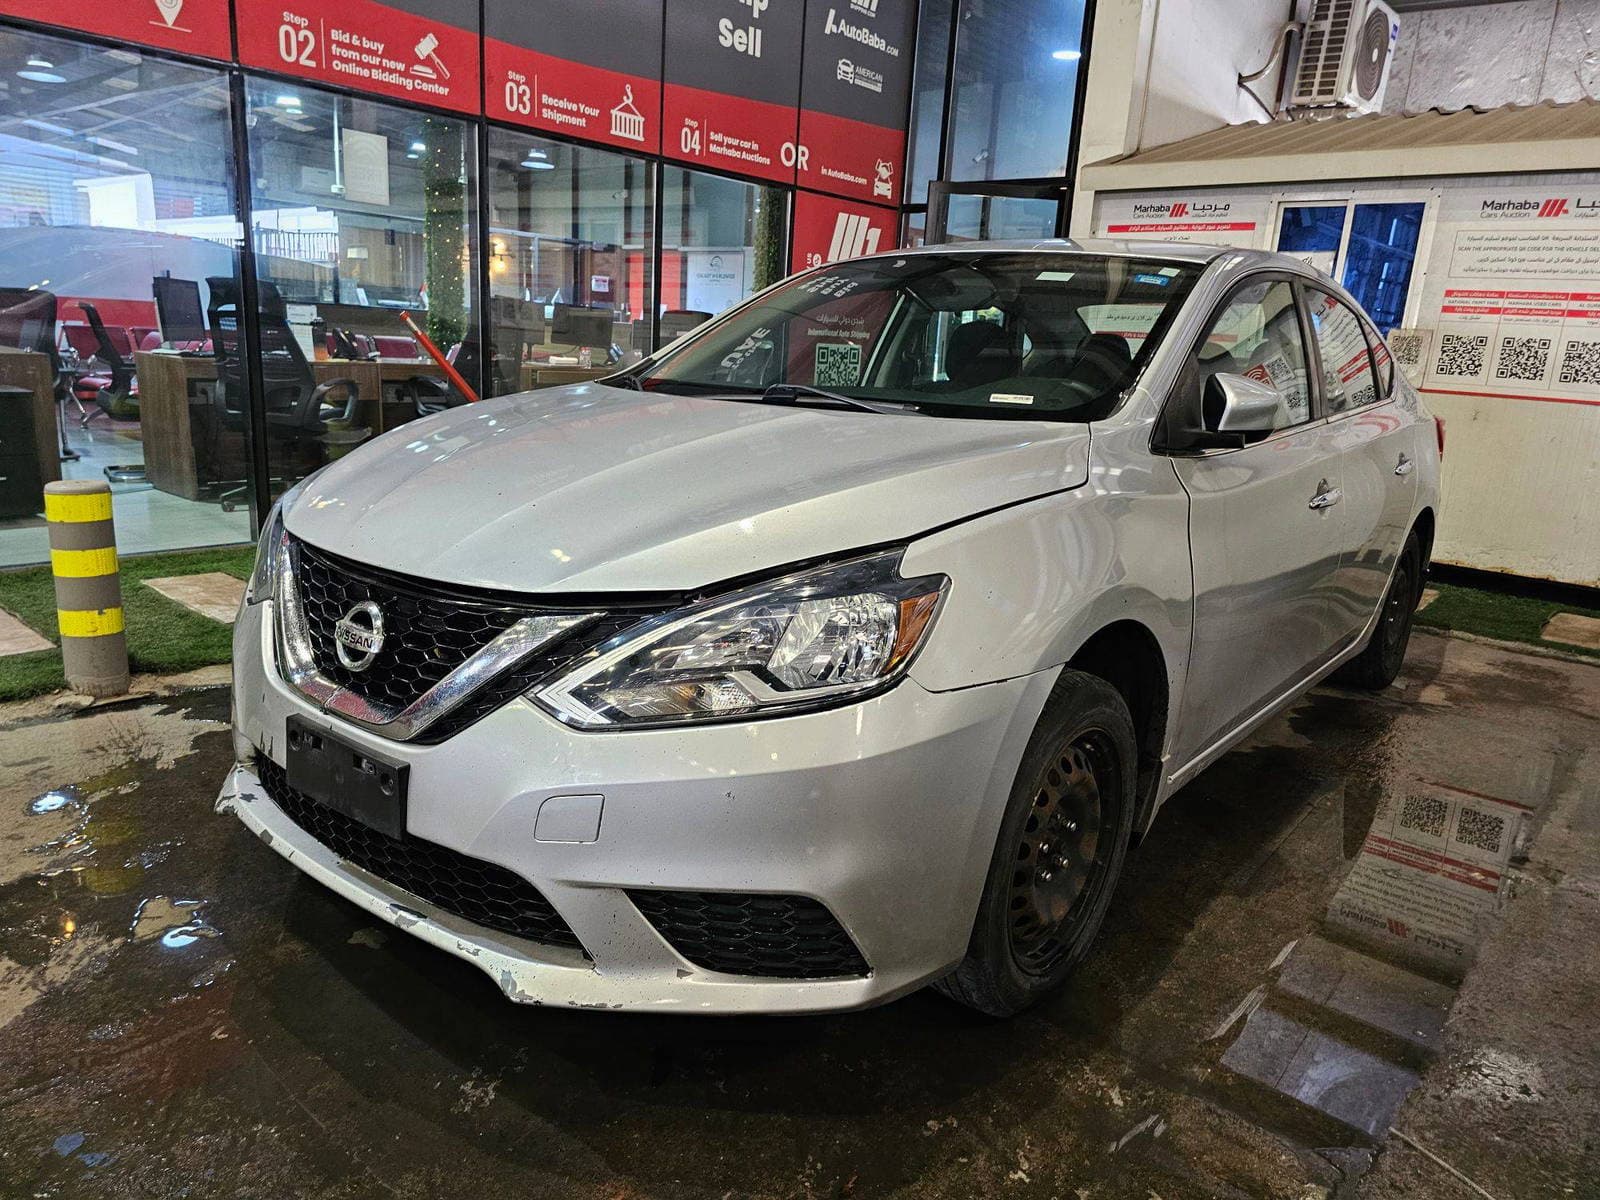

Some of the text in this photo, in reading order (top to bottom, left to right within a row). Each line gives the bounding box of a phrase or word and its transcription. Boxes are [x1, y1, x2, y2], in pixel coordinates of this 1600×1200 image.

[282, 11, 309, 28] Step
[278, 24, 317, 68] 02
[330, 29, 385, 55] Bid & buy
[717, 17, 762, 58] Sell
[331, 44, 406, 72] from our new
[332, 60, 450, 96] Online Bidding Center
[507, 70, 526, 84] Step
[855, 65, 883, 82] AMERICAN
[505, 81, 531, 115] 03
[542, 94, 600, 117] Receive Your
[542, 108, 587, 127] Shipment
[684, 117, 699, 128] Step
[680, 127, 701, 156] 04
[709, 131, 759, 151] Sell your car in
[709, 143, 771, 166] Marhaba Auctions
[780, 141, 809, 171] OR
[821, 166, 828, 175] in
[1134, 203, 1170, 213] Marhaba
[1192, 203, 1230, 213] مرحبا
[1480, 211, 1531, 219] Cars Auction
[1481, 200, 1540, 211] Marhaba
